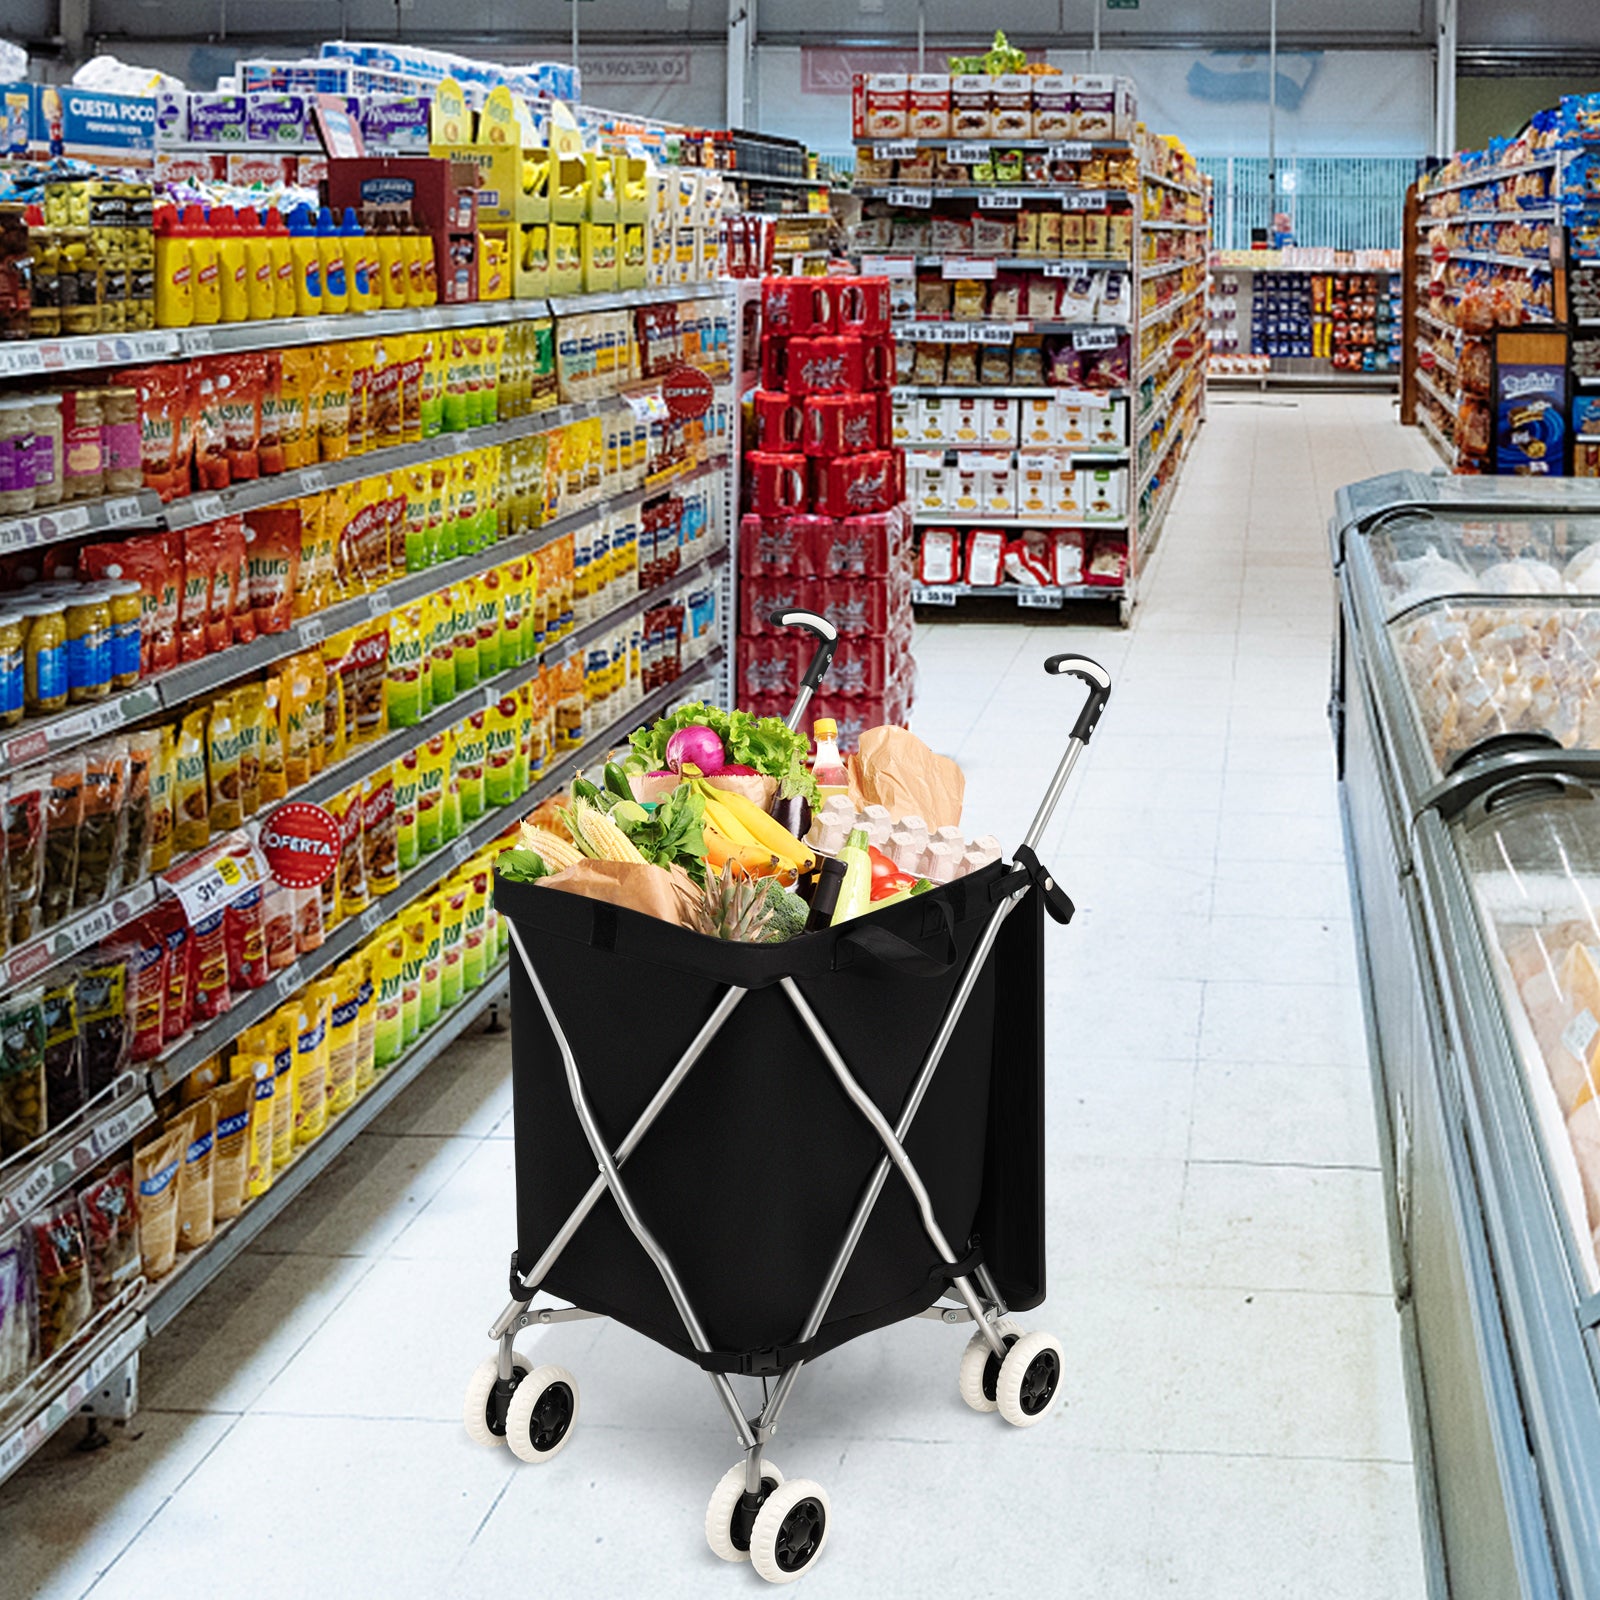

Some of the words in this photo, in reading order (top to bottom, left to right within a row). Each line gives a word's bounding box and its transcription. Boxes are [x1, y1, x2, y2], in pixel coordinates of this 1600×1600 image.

[70, 98, 119, 118] CUESTA
[120, 104, 155, 122] POCO
[267, 832, 333, 857] OFERTA
